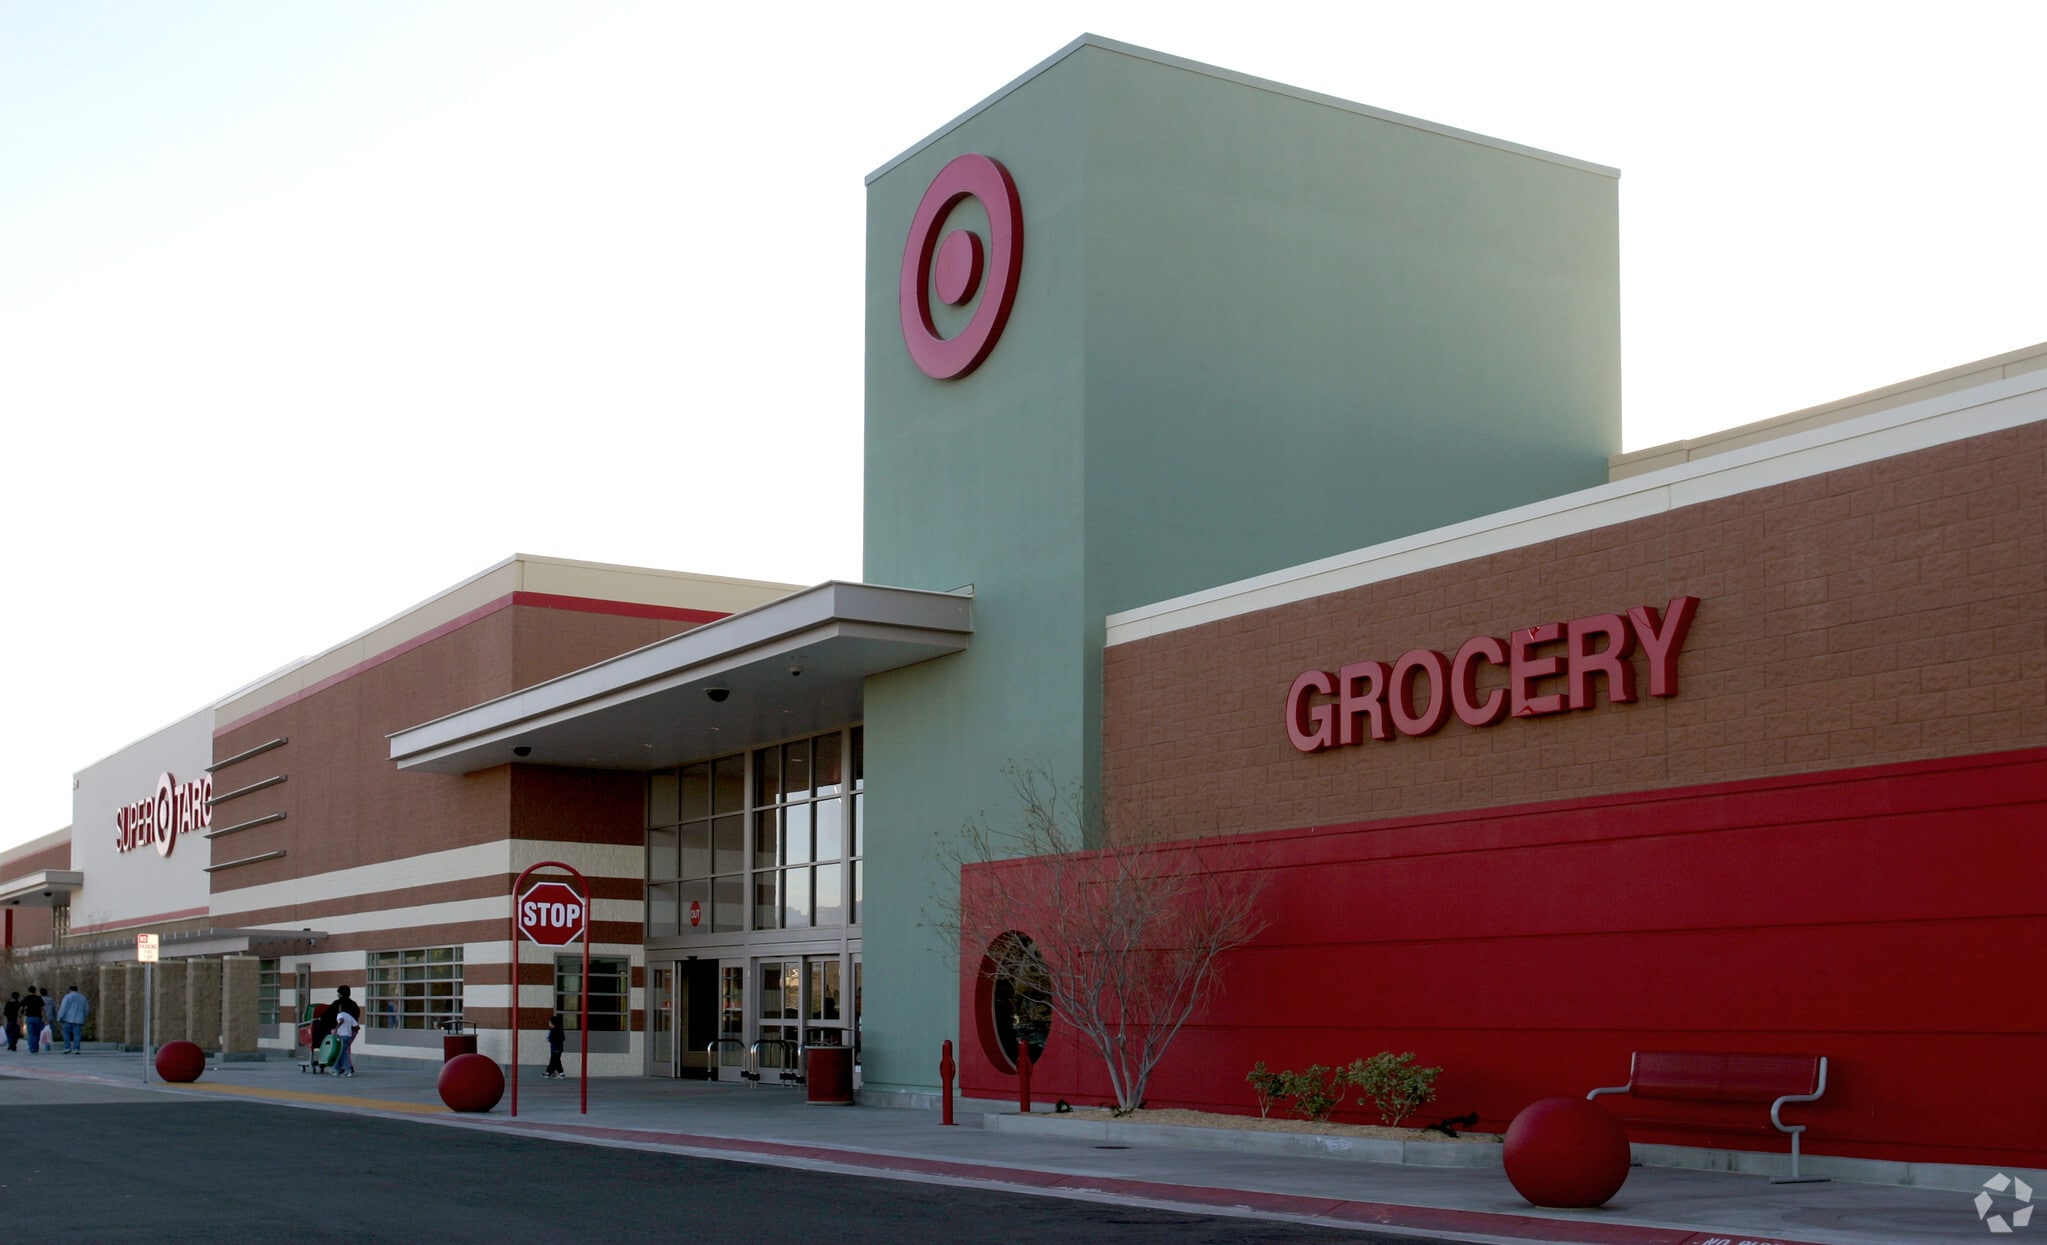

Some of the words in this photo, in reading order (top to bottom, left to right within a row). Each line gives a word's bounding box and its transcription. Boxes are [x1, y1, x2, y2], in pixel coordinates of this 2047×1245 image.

[1285, 596, 1700, 753] GROCERY
[116, 797, 155, 853] SUPER
[523, 901, 580, 928] STOP
[690, 909, 700, 919] OUT
